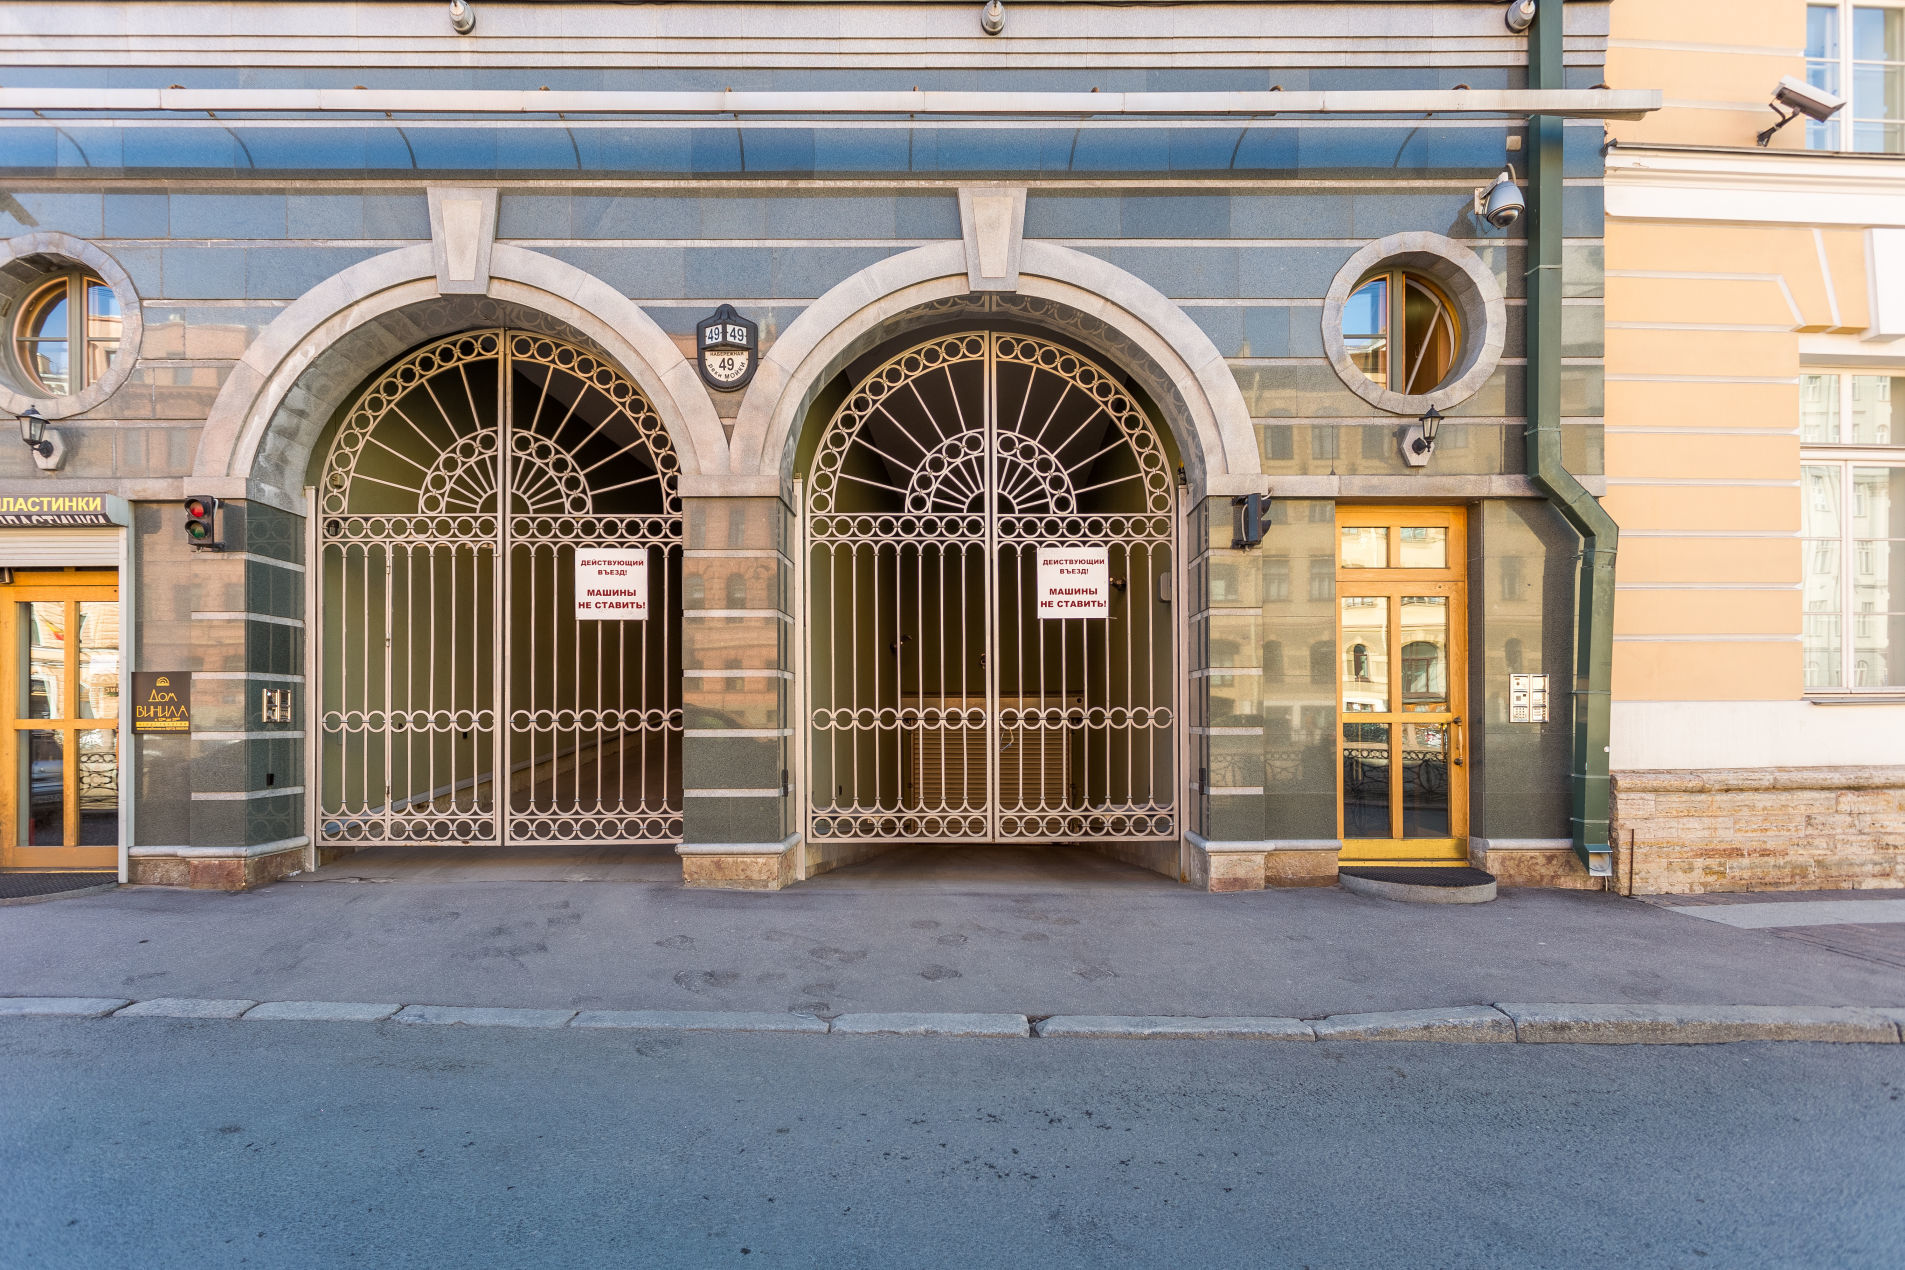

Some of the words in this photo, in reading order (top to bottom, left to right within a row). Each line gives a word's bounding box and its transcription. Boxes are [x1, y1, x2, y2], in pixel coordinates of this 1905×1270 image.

[708, 327, 720, 341] 49
[730, 327, 744, 341] 49
[719, 357, 735, 371] 49
[0, 497, 102, 512] ЛАСТИНКИ
[581, 559, 644, 567] ДЕЙСТВУЮЩИЙ
[1042, 558, 1105, 566] ДЕЙСТВУЮЩИЙ
[587, 589, 637, 597] МАШИНЫ
[1049, 588, 1098, 596] МАШИНЫ
[578, 601, 592, 609] НЕ
[594, 601, 646, 609] СТАВИТЬ!
[1040, 600, 1054, 608] НЕ
[1056, 600, 1107, 608] СТАВИТЬ!
